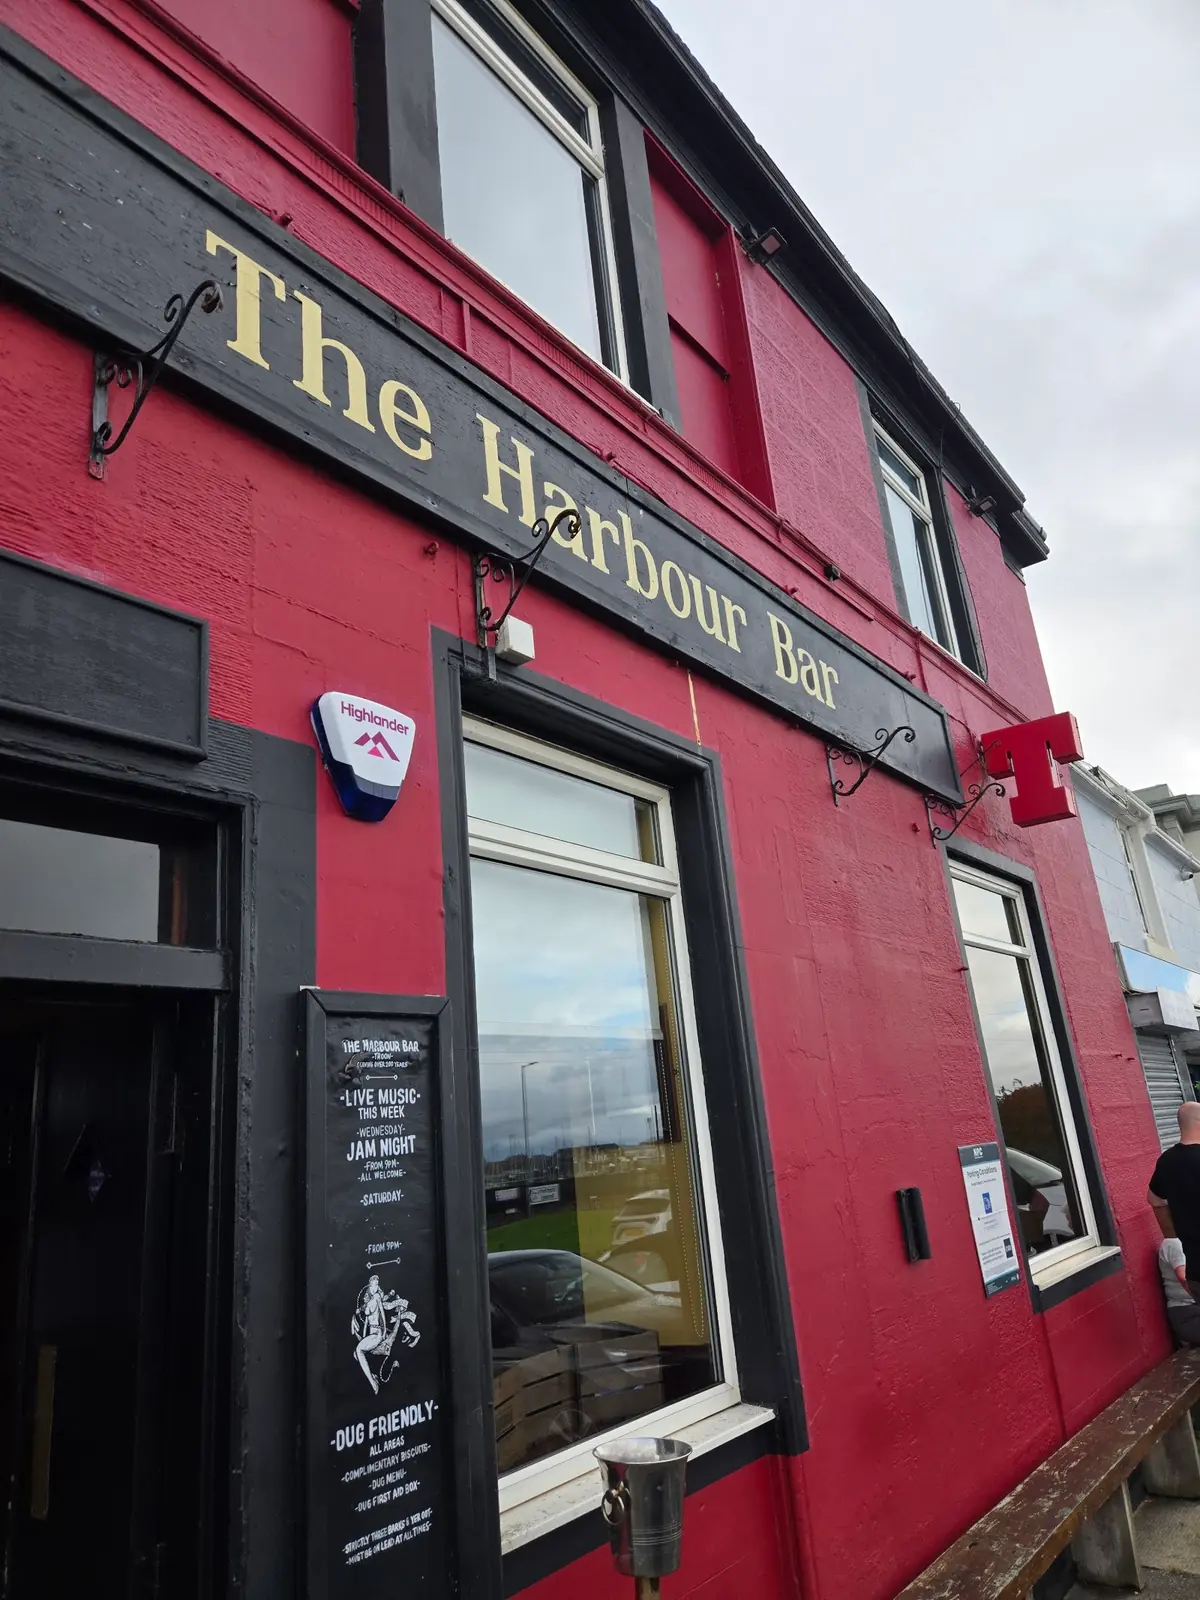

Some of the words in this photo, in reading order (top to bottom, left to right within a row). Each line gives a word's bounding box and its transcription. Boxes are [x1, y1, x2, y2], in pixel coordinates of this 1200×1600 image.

[206, 229, 433, 461] The
[476, 413, 747, 652] Harbour
[767, 611, 839, 710] Bar
[341, 701, 409, 735] Highlander
[342, 1040, 360, 1053] THE
[362, 1039, 401, 1053] HARBOUR
[402, 1040, 419, 1053] BAR
[358, 1106, 378, 1120] THIS
[380, 1105, 405, 1119] WEEK
[346, 1138, 377, 1161] JAM
[380, 1135, 416, 1157] NIGHT
[369, 1445, 382, 1457] ALL
[383, 1435, 405, 1452] AREAS
[372, 1490, 392, 1507] FIRST
[392, 1485, 404, 1500] AID
[371, 1527, 388, 1542] THREE
[387, 1519, 406, 1535] BARKS
[410, 1512, 421, 1525] YER
[364, 1547, 373, 1559] BE
[380, 1537, 395, 1551] LEAD
[395, 1533, 403, 1546] AT
[403, 1529, 413, 1542] ALL
